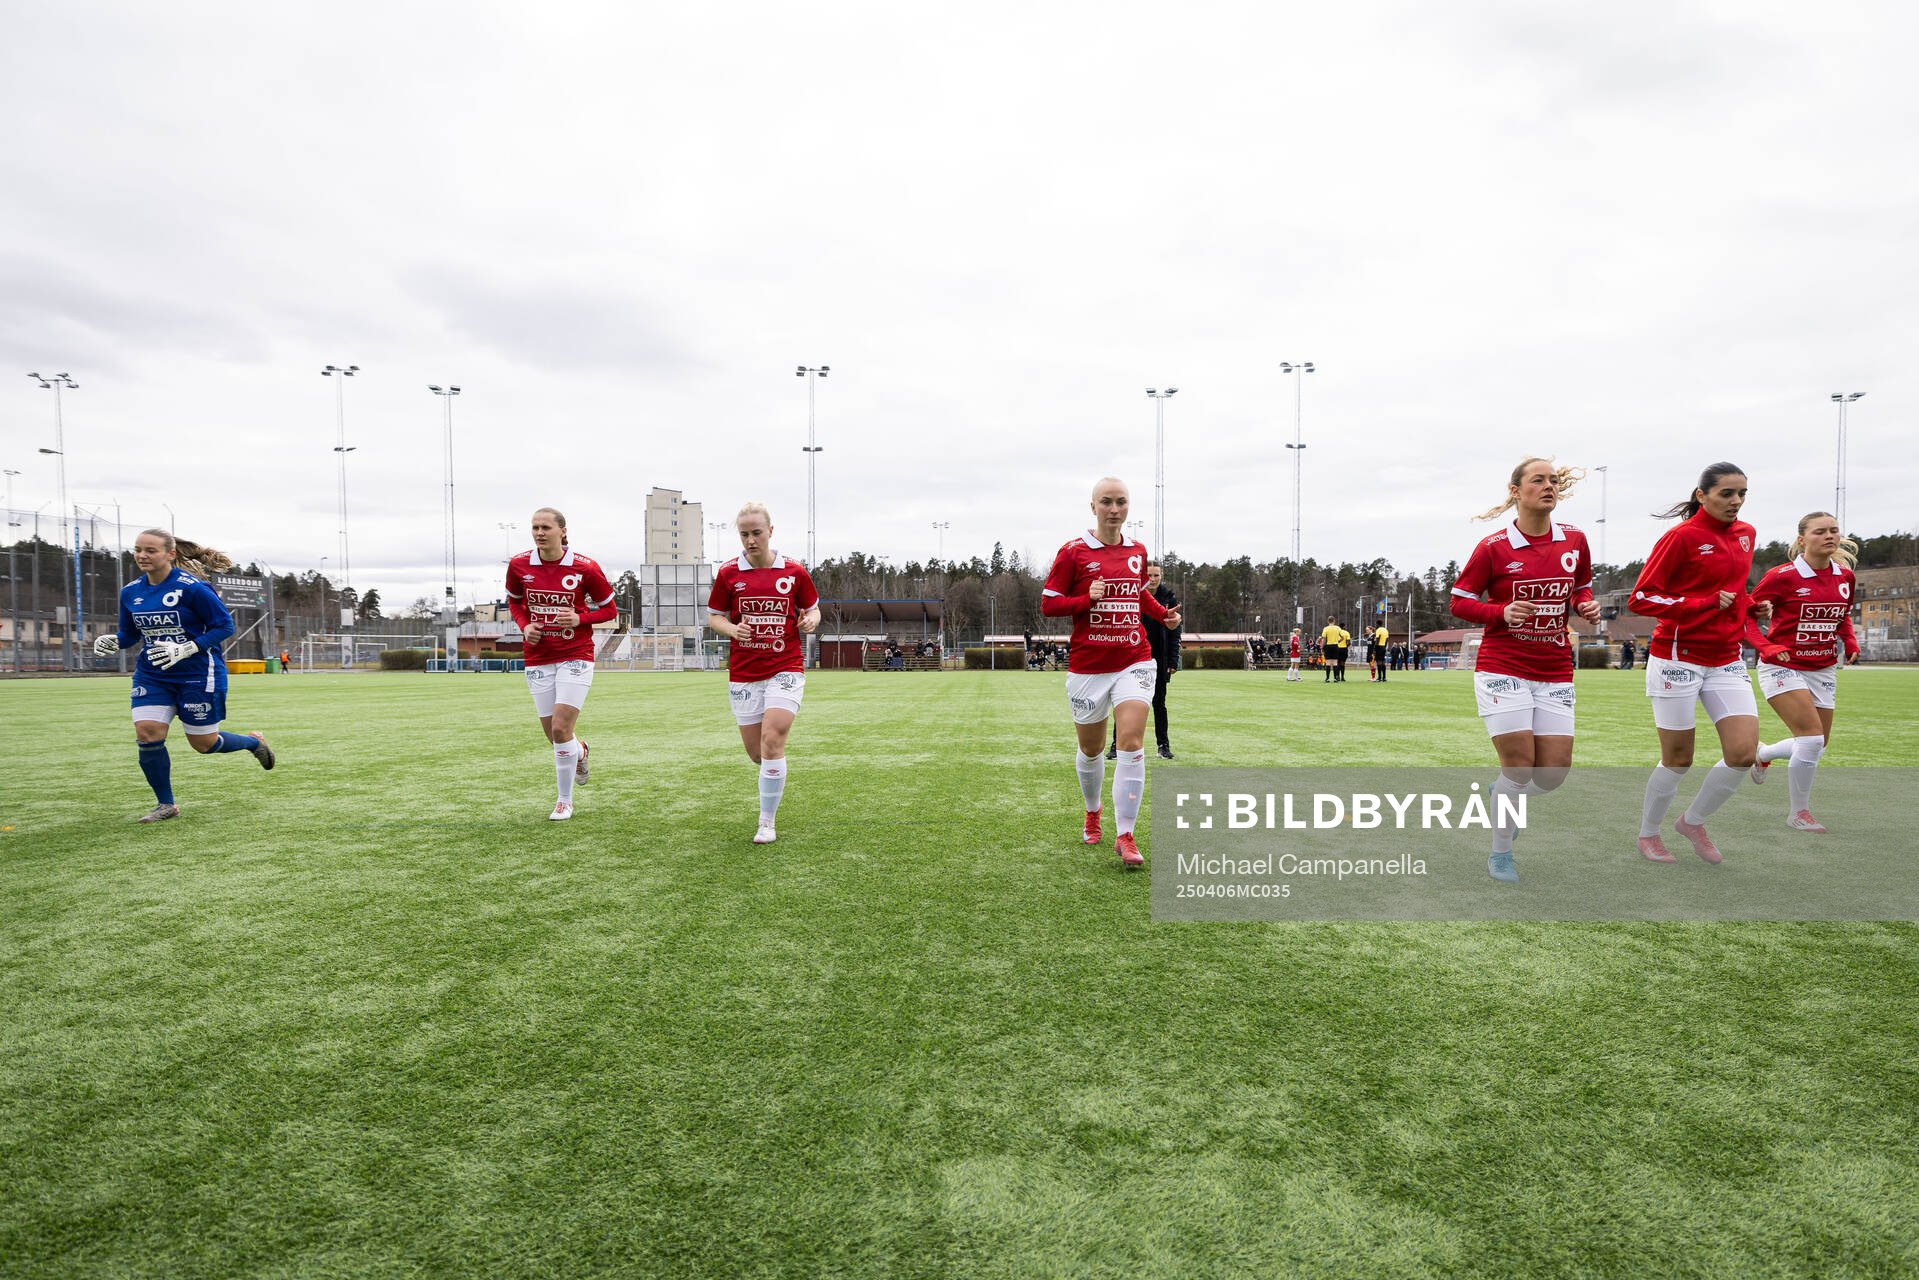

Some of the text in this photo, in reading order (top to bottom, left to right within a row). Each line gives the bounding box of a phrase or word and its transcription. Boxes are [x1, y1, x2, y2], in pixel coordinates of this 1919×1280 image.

[217, 577, 263, 587] LASERDOME
[1090, 613, 1140, 625] D-LAB
[1088, 633, 1129, 643] outokumpu
[1662, 668, 1687, 676] NORDIC
[1487, 679, 1510, 689] NORDIC
